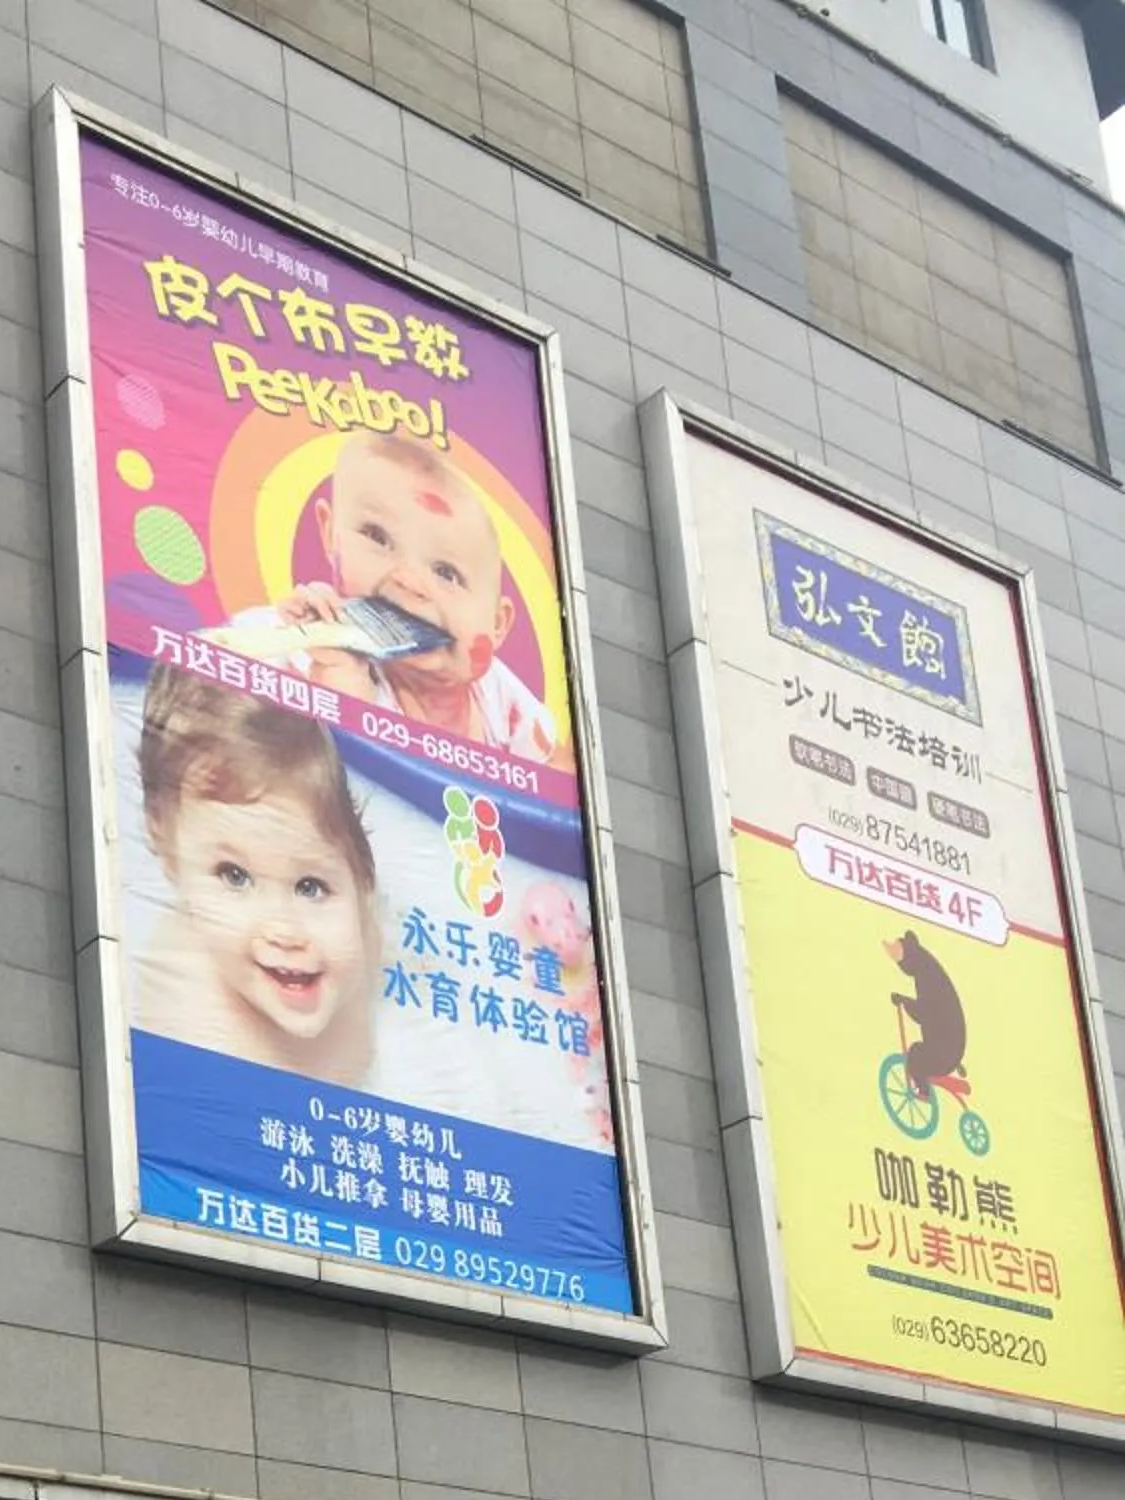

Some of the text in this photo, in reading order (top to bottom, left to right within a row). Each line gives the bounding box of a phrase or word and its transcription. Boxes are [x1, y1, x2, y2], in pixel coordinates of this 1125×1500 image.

[143, 255, 470, 381] 皮个布早教
[150, 625, 539, 793] 万达百货四层 029-68653161
[783, 675, 982, 784] 少儿书法培训
[402, 906, 567, 996] 永乐婴童
[383, 963, 591, 1057] 水育体验馆
[260, 1117, 515, 1208] 游泳 洗澡 抚触 理发
[309, 1096, 462, 1161] 0-6岁婴幼儿
[197, 1187, 585, 1302] 万达百货二层 029 89529776
[280, 1157, 504, 1238] 小儿推拿 母婴用品
[848, 1201, 1062, 1300] 少儿美术空间
